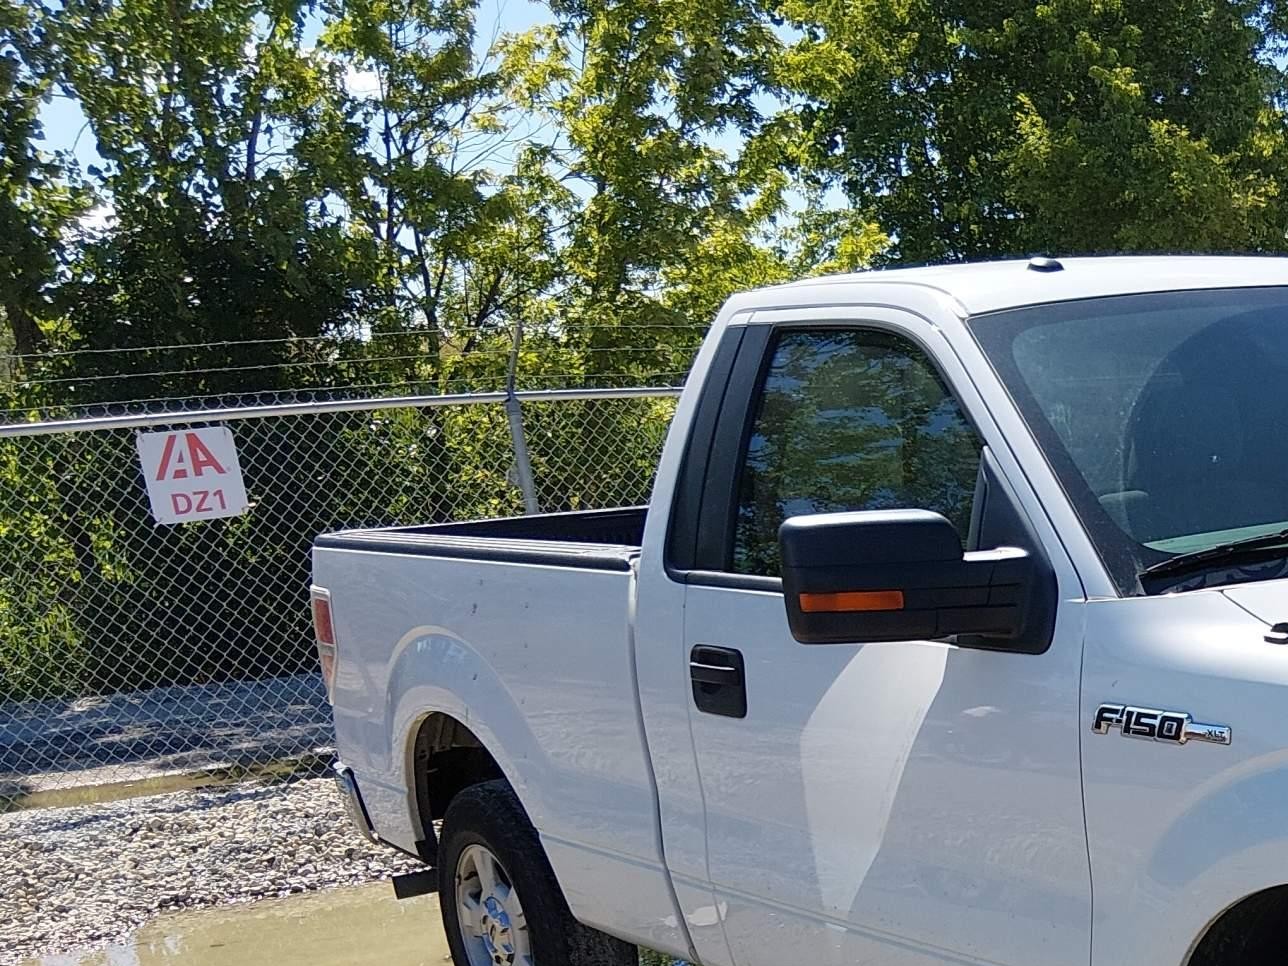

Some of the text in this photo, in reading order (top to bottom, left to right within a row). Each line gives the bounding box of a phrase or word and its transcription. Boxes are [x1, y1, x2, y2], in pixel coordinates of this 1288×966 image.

[170, 489, 227, 516] DZ1
[1092, 703, 1227, 745] F-150 XLT
